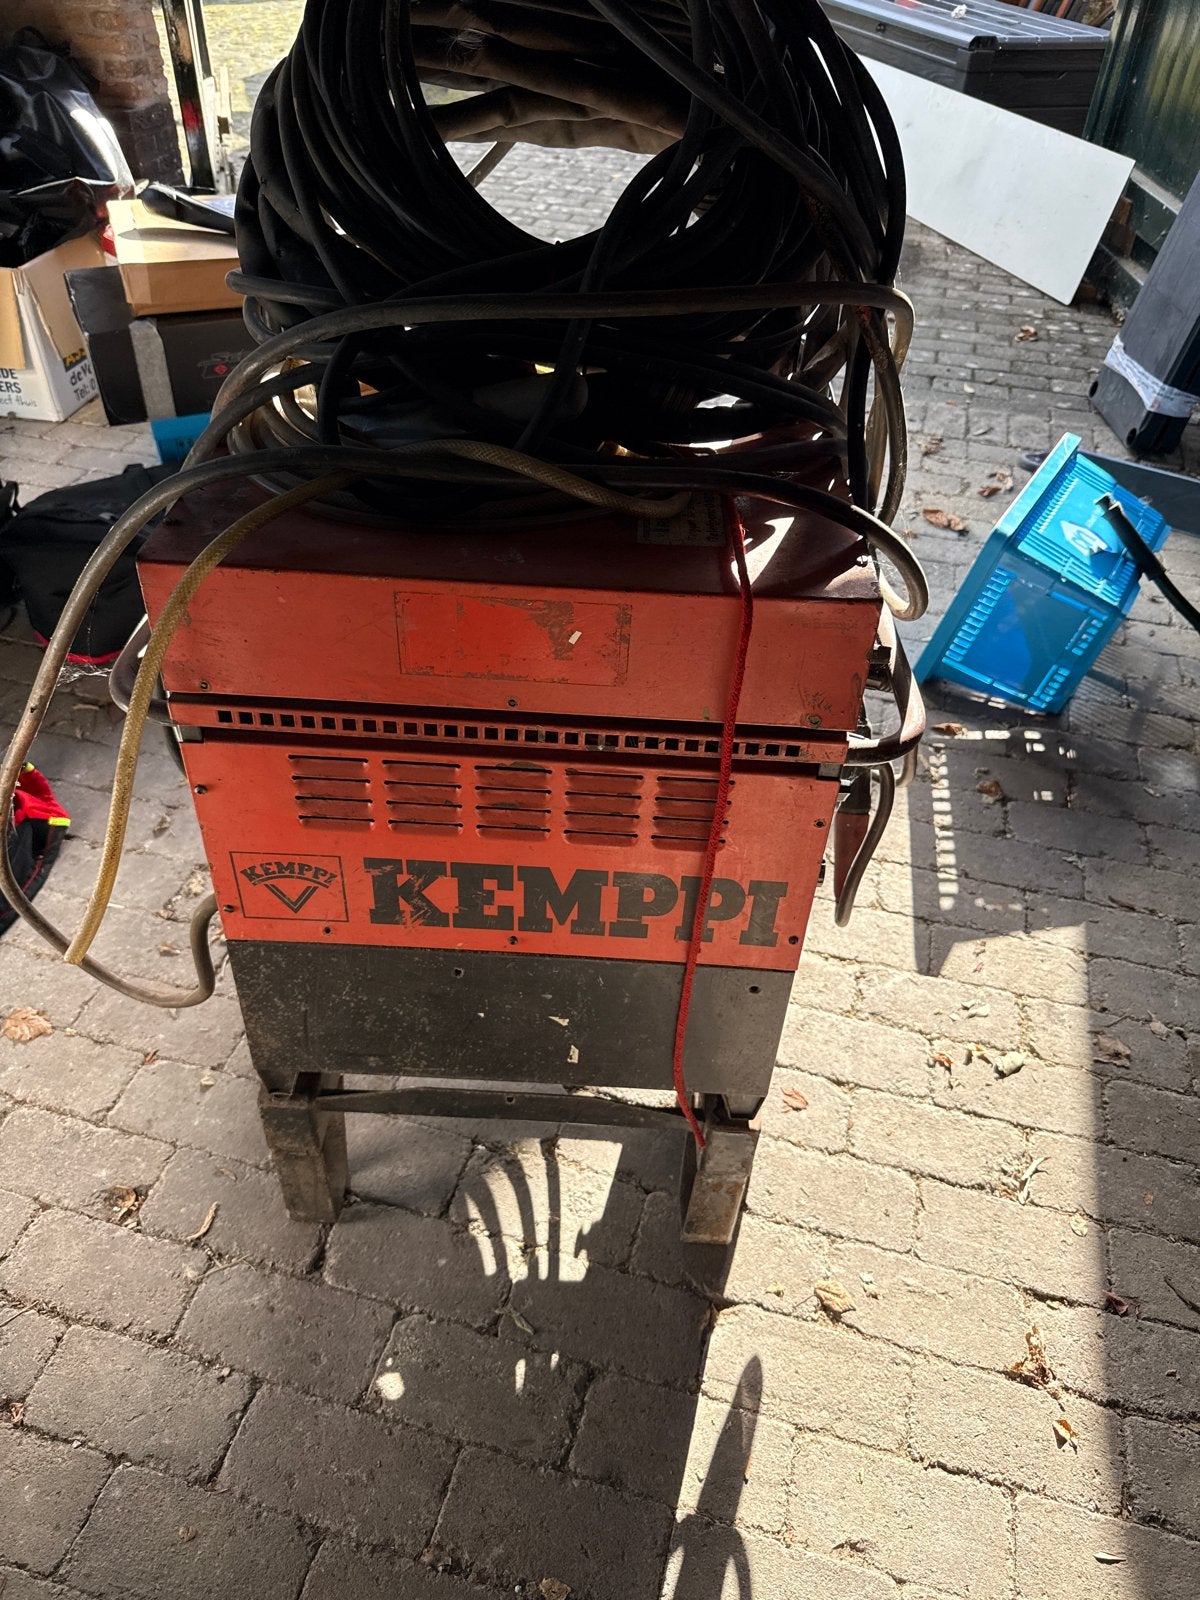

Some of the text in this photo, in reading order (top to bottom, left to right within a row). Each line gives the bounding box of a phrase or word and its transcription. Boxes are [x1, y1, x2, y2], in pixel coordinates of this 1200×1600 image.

[0, 368, 18, 380] DE
[240, 861, 338, 885] KEMPPI
[364, 857, 788, 948] KEMPPI
